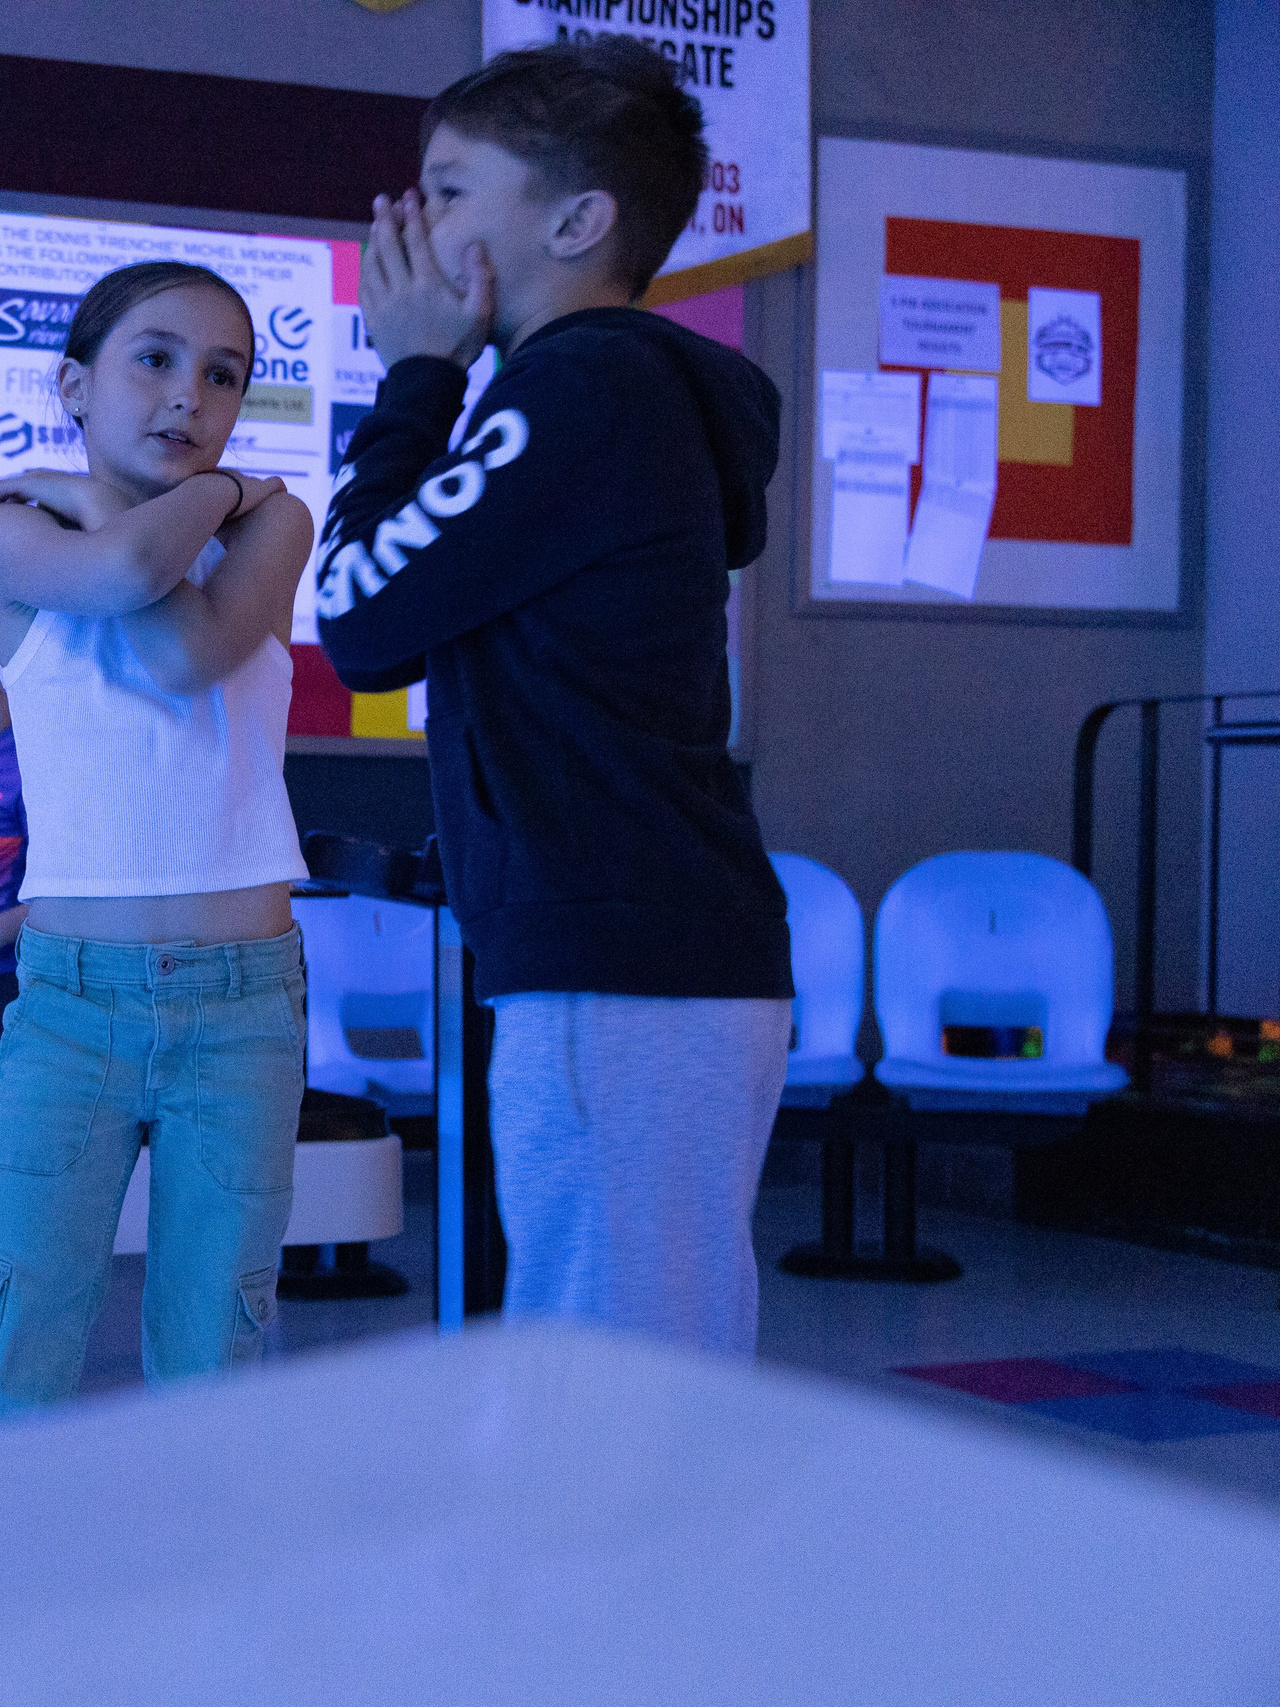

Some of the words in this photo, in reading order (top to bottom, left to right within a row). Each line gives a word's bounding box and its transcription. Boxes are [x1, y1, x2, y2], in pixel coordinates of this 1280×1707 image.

[516, 0, 776, 39] PIONSHIPS
[713, 203, 745, 235] ON
[2, 226, 31, 241] THE
[35, 229, 91, 247] DENNIS
[183, 243, 236, 260] MICHEL
[240, 246, 315, 267] MEMORIAL
[6, 244, 35, 260] THE
[251, 265, 293, 281] THEIR
